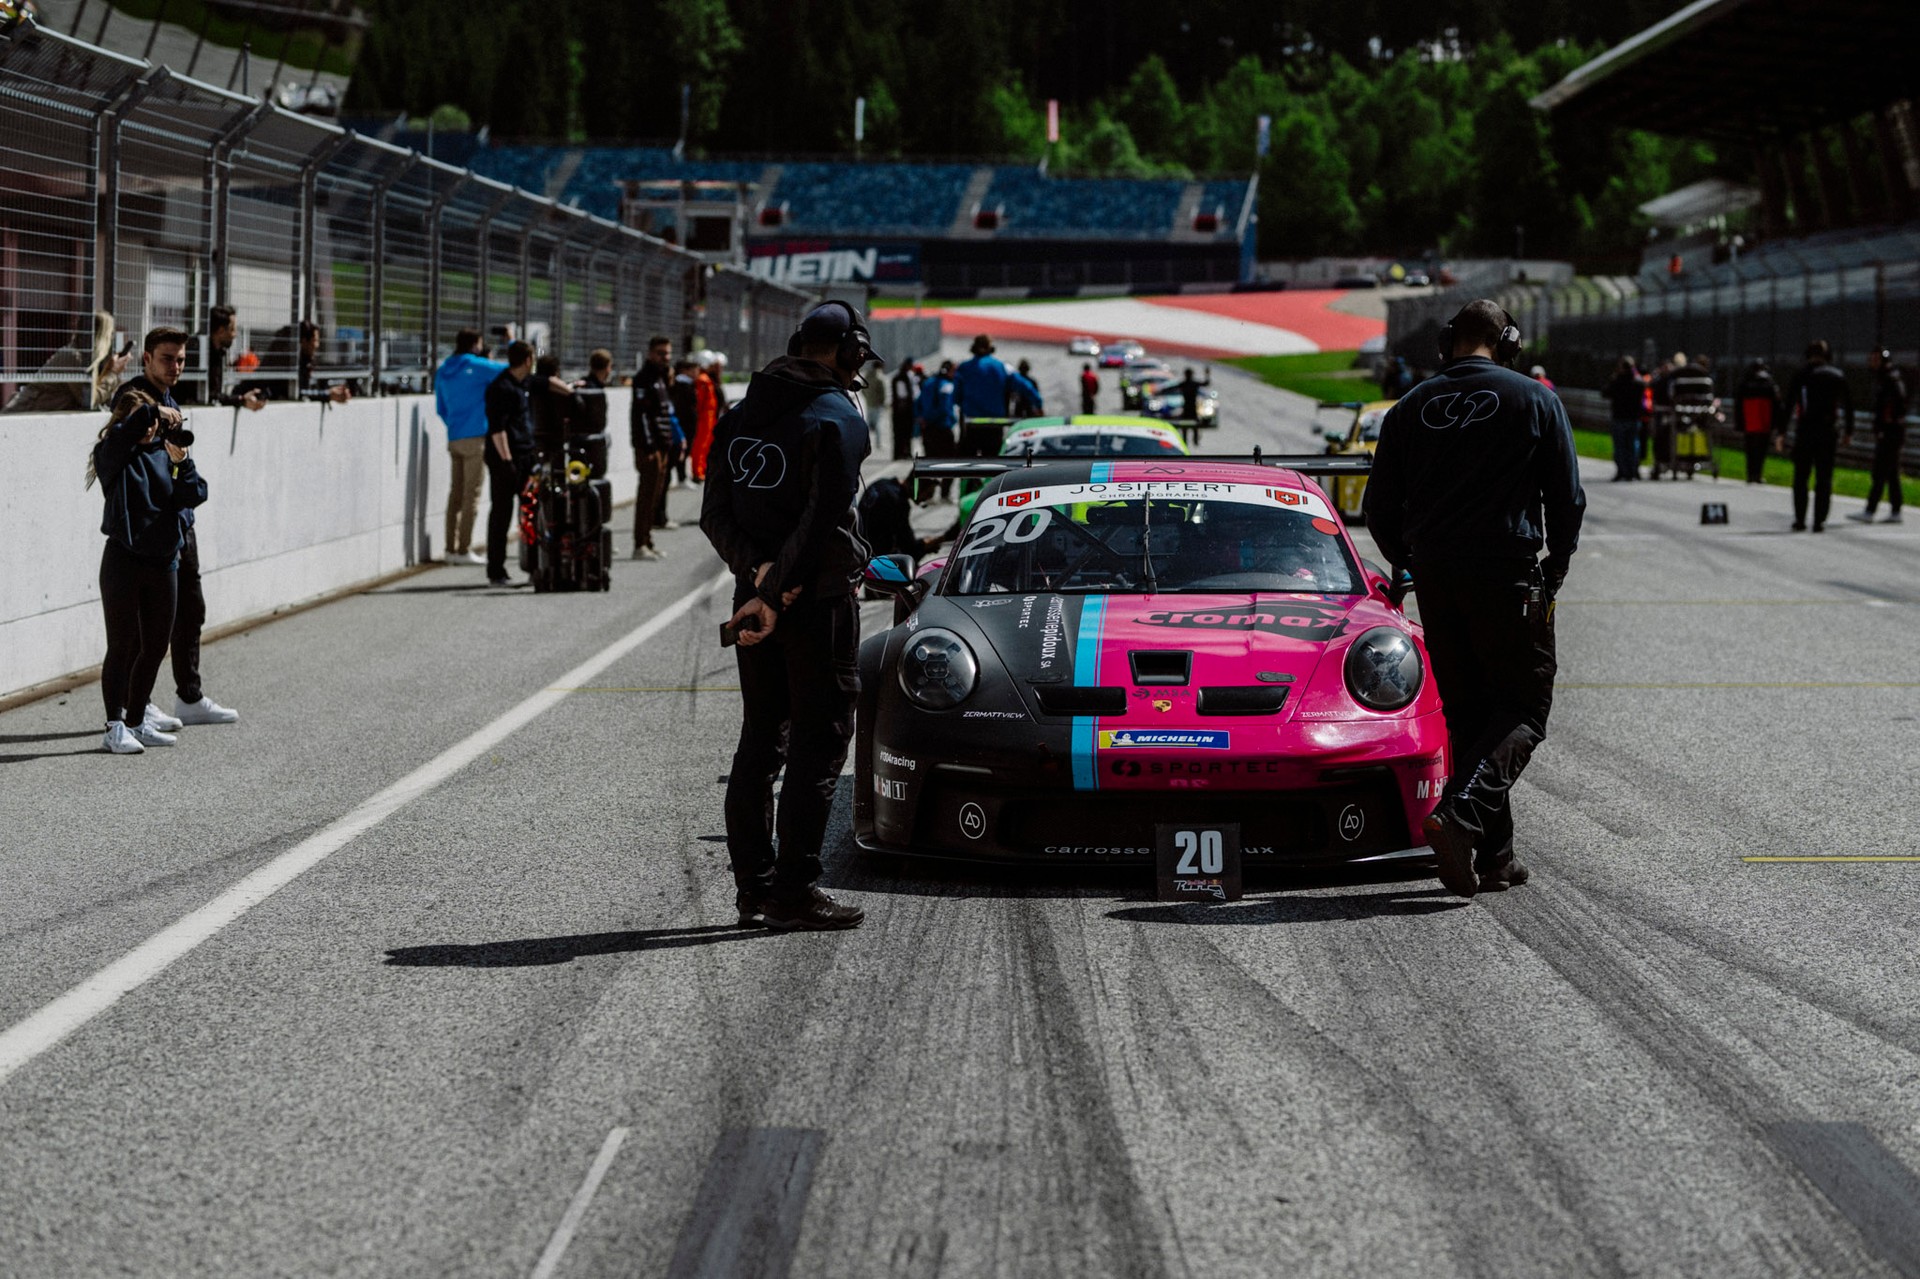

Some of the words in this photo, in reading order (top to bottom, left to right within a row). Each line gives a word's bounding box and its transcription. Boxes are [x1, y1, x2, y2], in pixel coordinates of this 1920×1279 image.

[1071, 485, 1107, 494] JO
[1118, 483, 1236, 493] SIFFERT
[958, 508, 1053, 558] 20
[1019, 601, 1033, 628] SPORTEC
[1137, 611, 1341, 629] cromax
[1136, 735, 1214, 743] MICHELIN
[1150, 761, 1279, 775] SPORTEC
[1044, 845, 1156, 855] carrosse
[1174, 830, 1223, 875] 20
